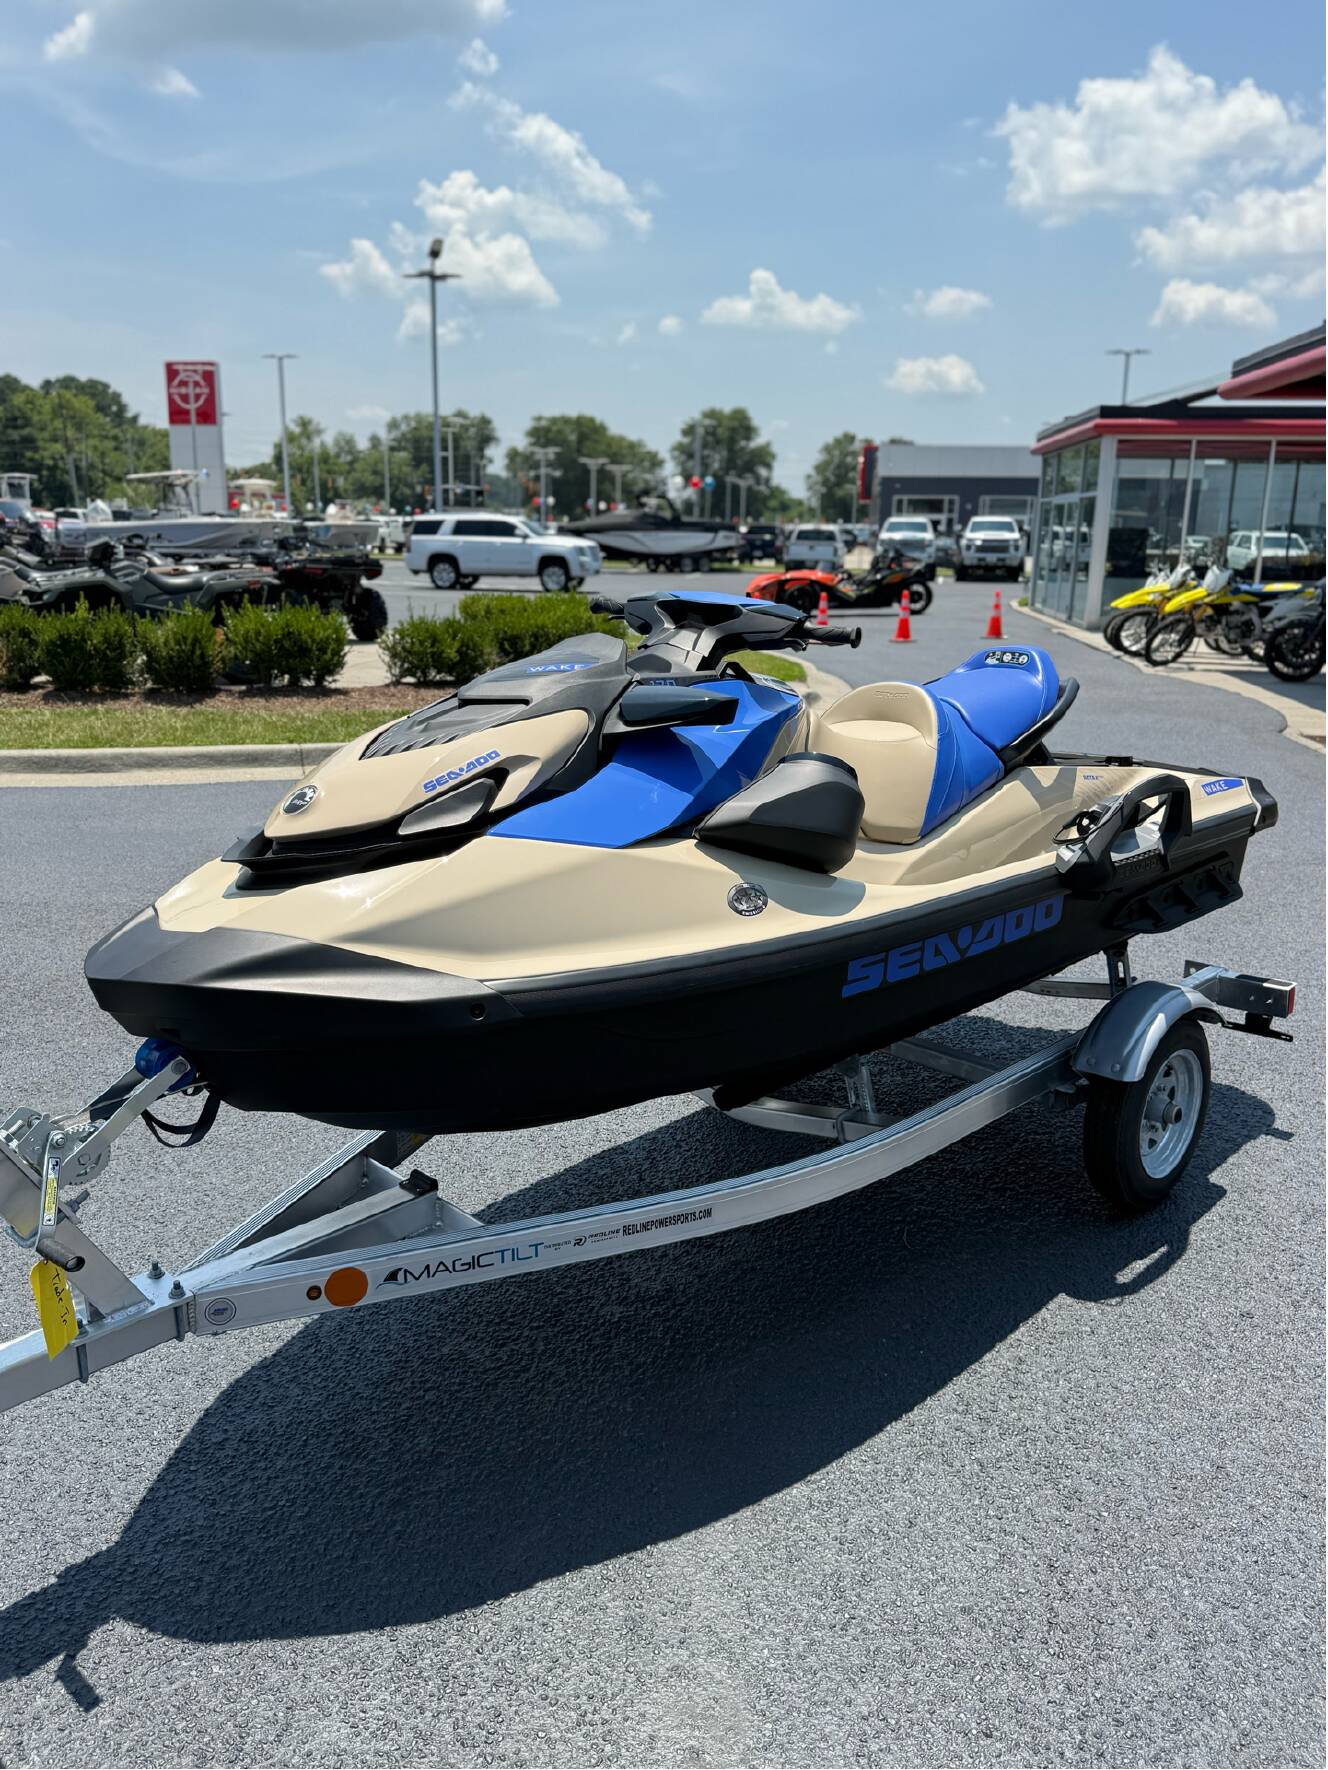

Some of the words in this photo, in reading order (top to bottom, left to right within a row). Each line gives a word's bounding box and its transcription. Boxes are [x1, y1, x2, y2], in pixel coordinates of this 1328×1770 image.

[529, 663, 585, 672] WAKE
[1203, 780, 1228, 795] WAKE
[622, 1207, 713, 1237] REDLINEPOWERSPORTS.COM
